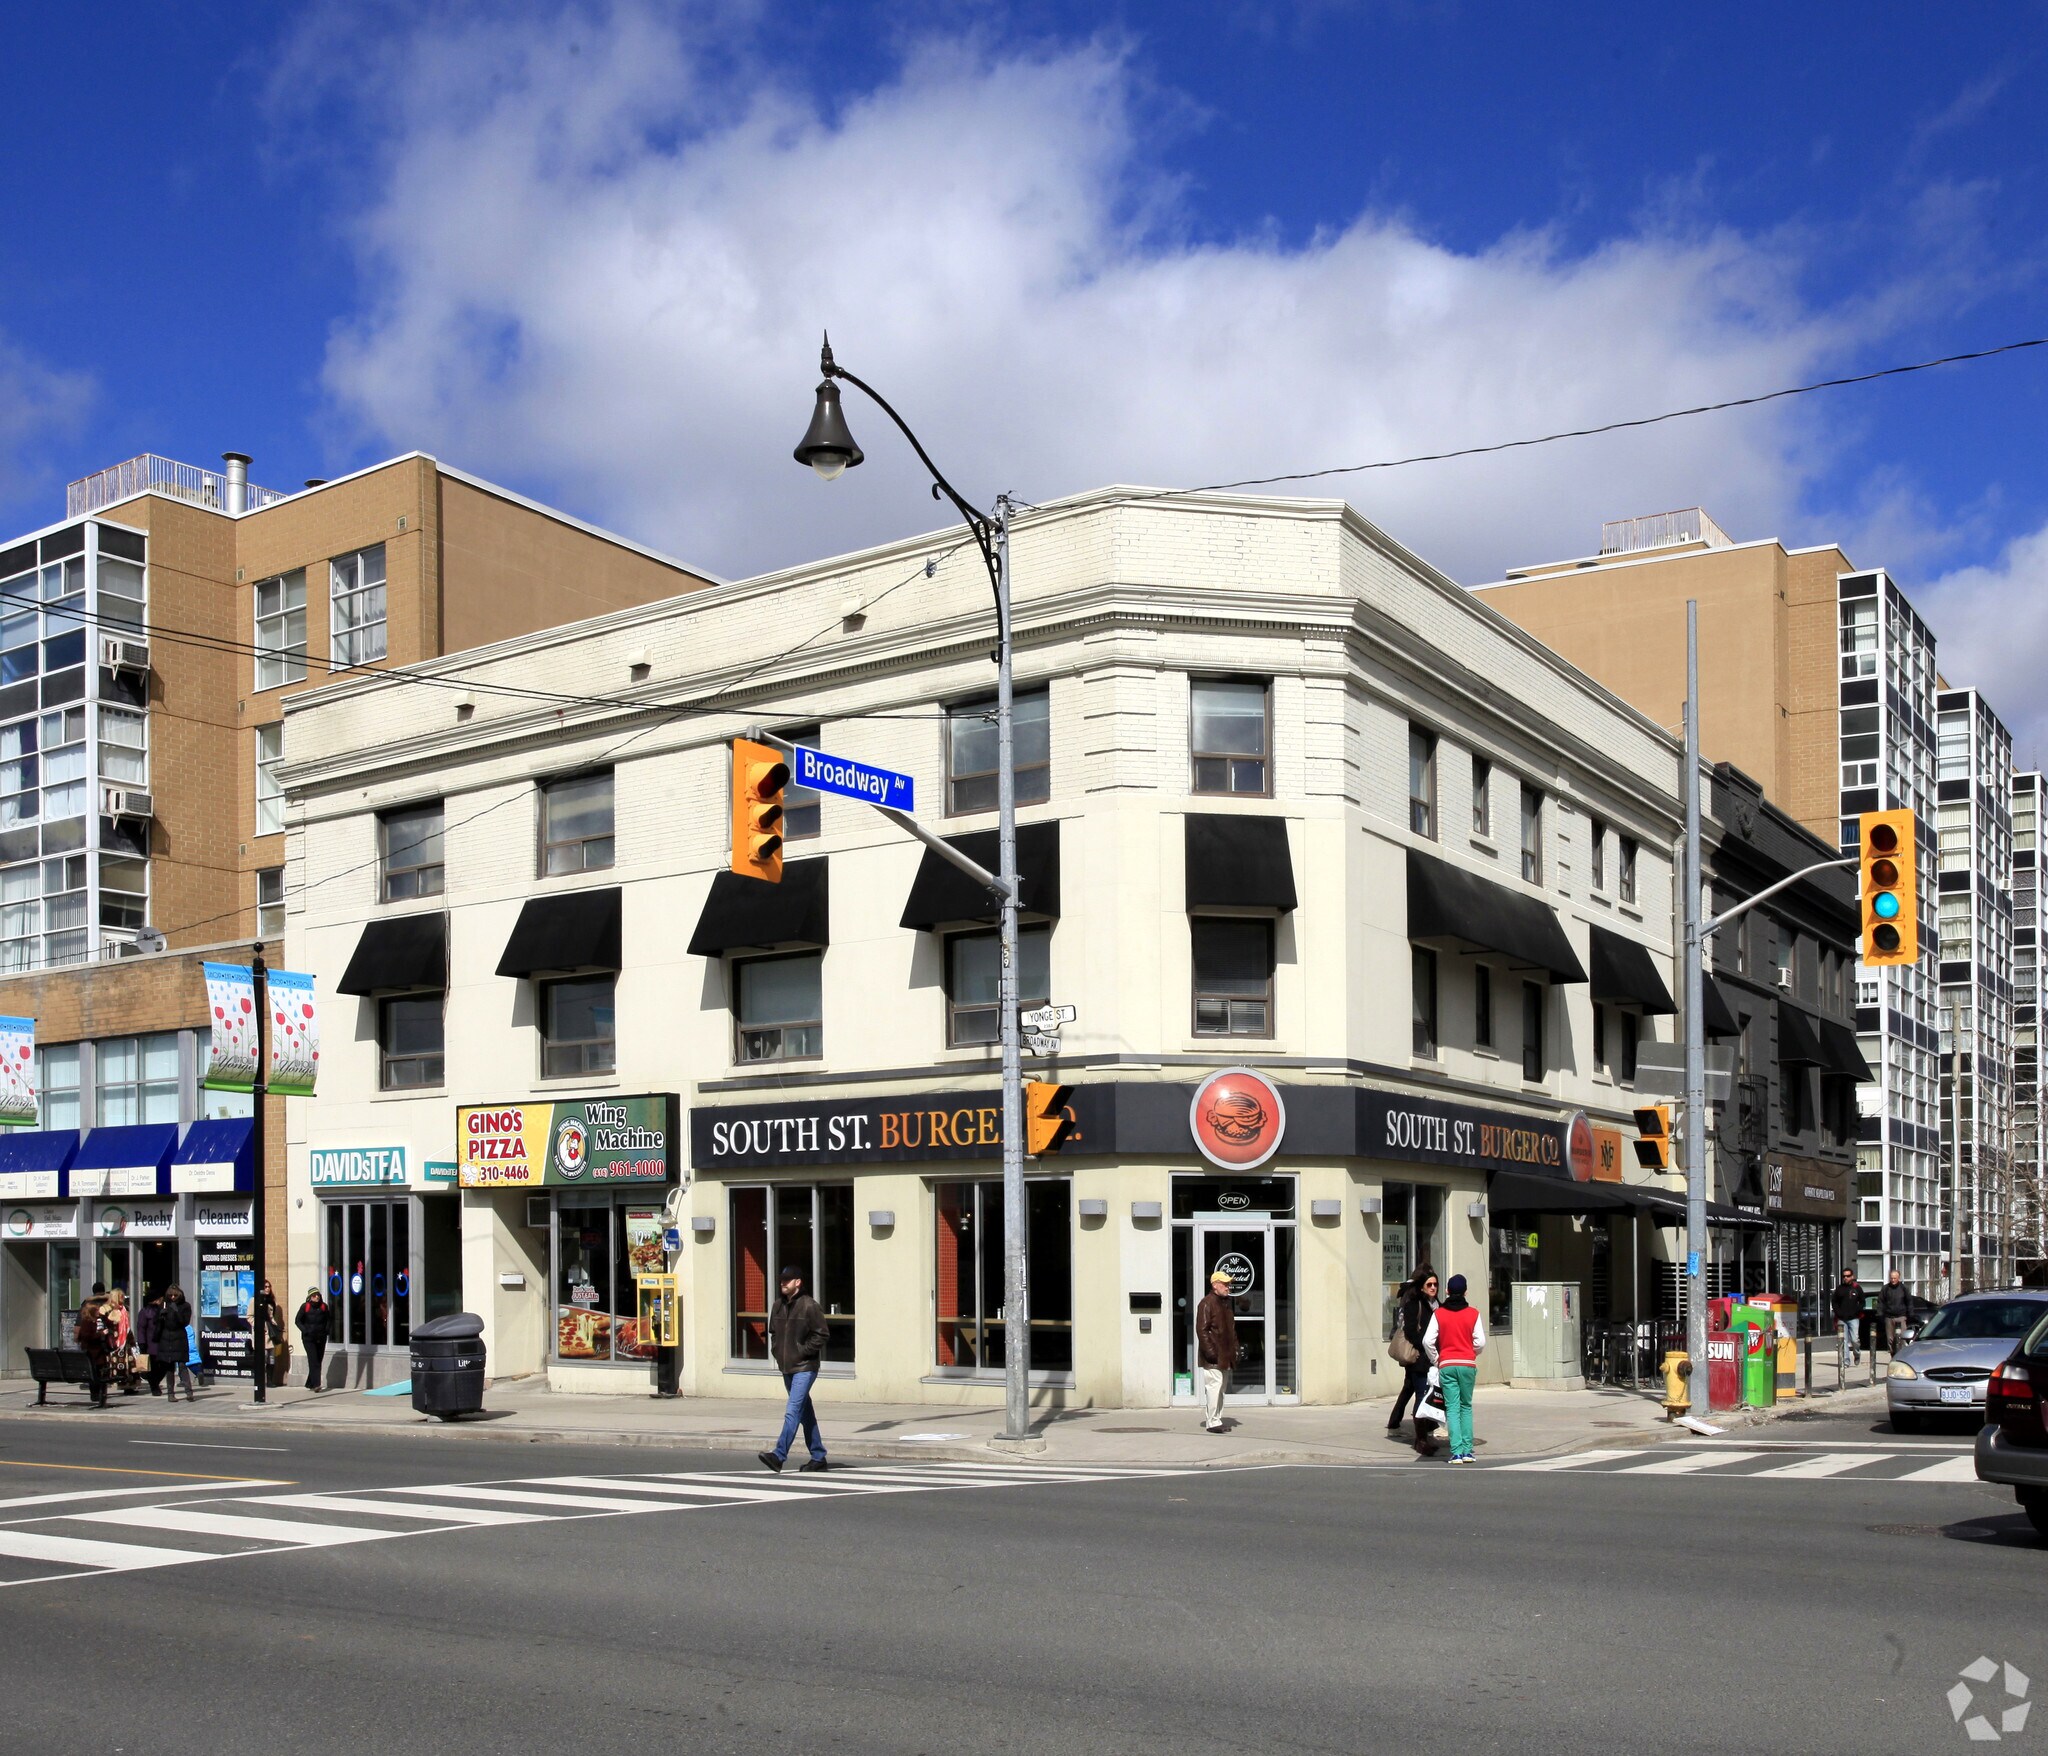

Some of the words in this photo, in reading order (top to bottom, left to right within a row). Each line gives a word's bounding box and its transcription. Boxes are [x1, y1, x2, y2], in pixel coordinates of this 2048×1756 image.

[804, 751, 889, 803] Broadway
[894, 776, 906, 790] Av
[1029, 1010, 1054, 1023] YONGE
[1056, 1008, 1067, 1020] ST.
[1022, 1034, 1050, 1048] BROADWAY
[214, 1054, 254, 1080] Yonge
[277, 1059, 315, 1084] Yonge
[468, 1108, 523, 1133] GINO'S
[585, 1102, 626, 1130] Wing
[595, 1127, 664, 1151] Machine
[712, 1117, 819, 1156] SOUTH
[828, 1115, 871, 1152] ST.
[880, 1108, 1003, 1150] BURGE
[1386, 1109, 1448, 1152] SOUTH
[1453, 1119, 1476, 1156] ST.
[1480, 1123, 1541, 1165] BURGER
[468, 1137, 527, 1161] PIZZA
[480, 1164, 529, 1182] 310-4466
[609, 1159, 665, 1177] 961-1000
[1220, 1196, 1247, 1205] OPEN
[135, 1209, 173, 1231] Peachy
[199, 1207, 249, 1225] Cleaners
[216, 1241, 237, 1250] SPECIAL
[202, 1254, 220, 1262] WEDDING
[220, 1254, 237, 1262] DRESSES
[1220, 1263, 1250, 1273] Poutine
[202, 1331, 232, 1339] Professional
[1708, 1342, 1733, 1360] SUN
